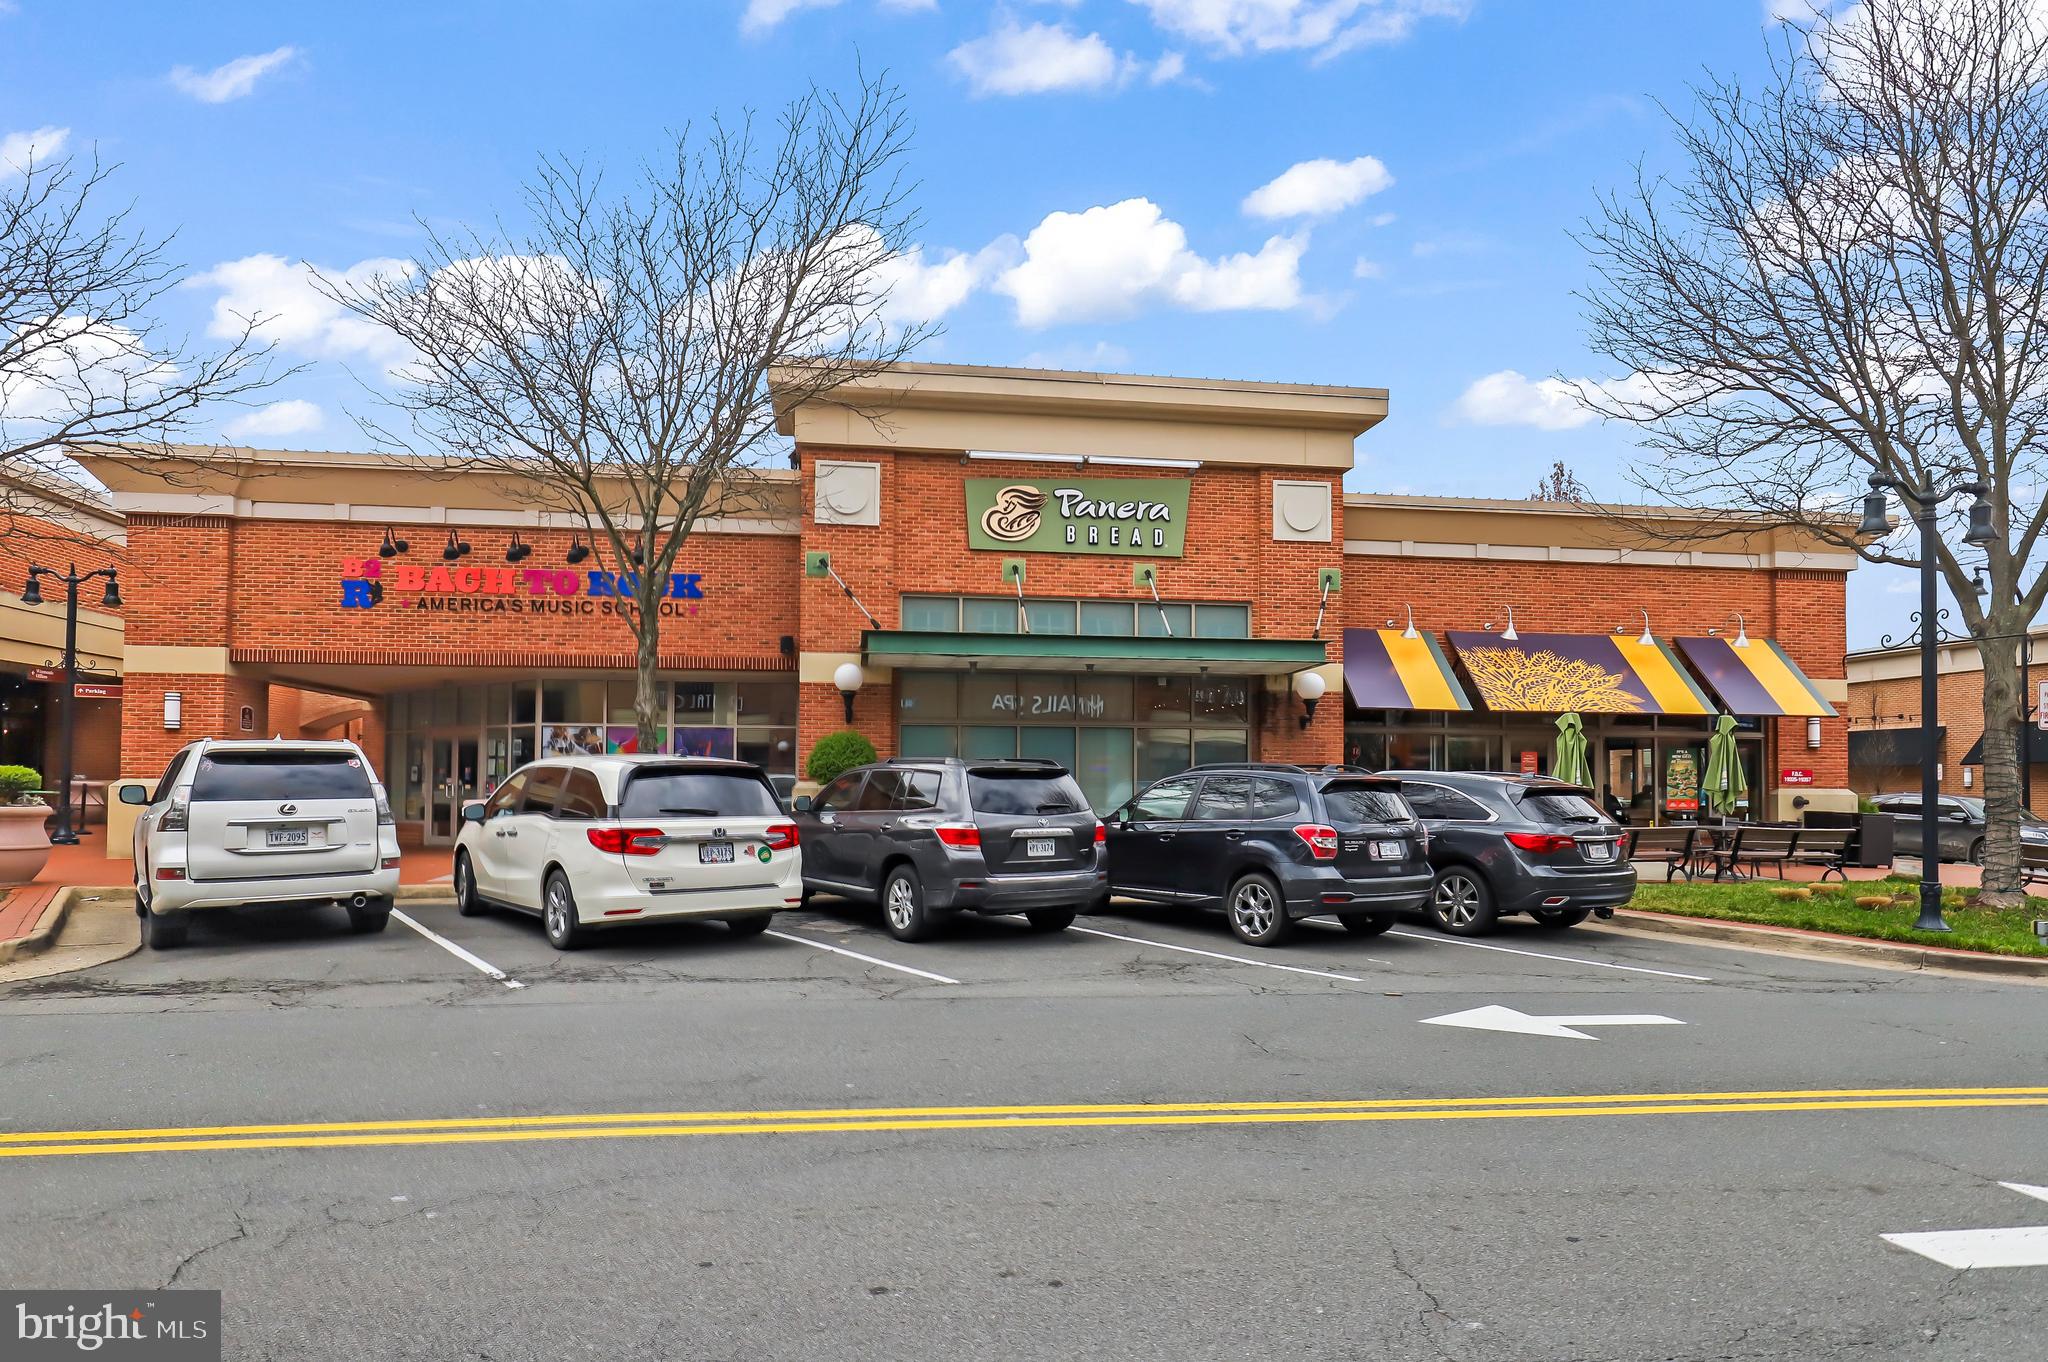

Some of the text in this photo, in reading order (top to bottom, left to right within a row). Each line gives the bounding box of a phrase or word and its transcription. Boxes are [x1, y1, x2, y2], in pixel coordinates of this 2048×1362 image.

[1053, 488, 1171, 522] Panera
[1065, 525, 1165, 547] BREAD
[394, 566, 704, 599] BACH TO ROK
[416, 597, 684, 617] AMERICA'S MUSIC SCHOL
